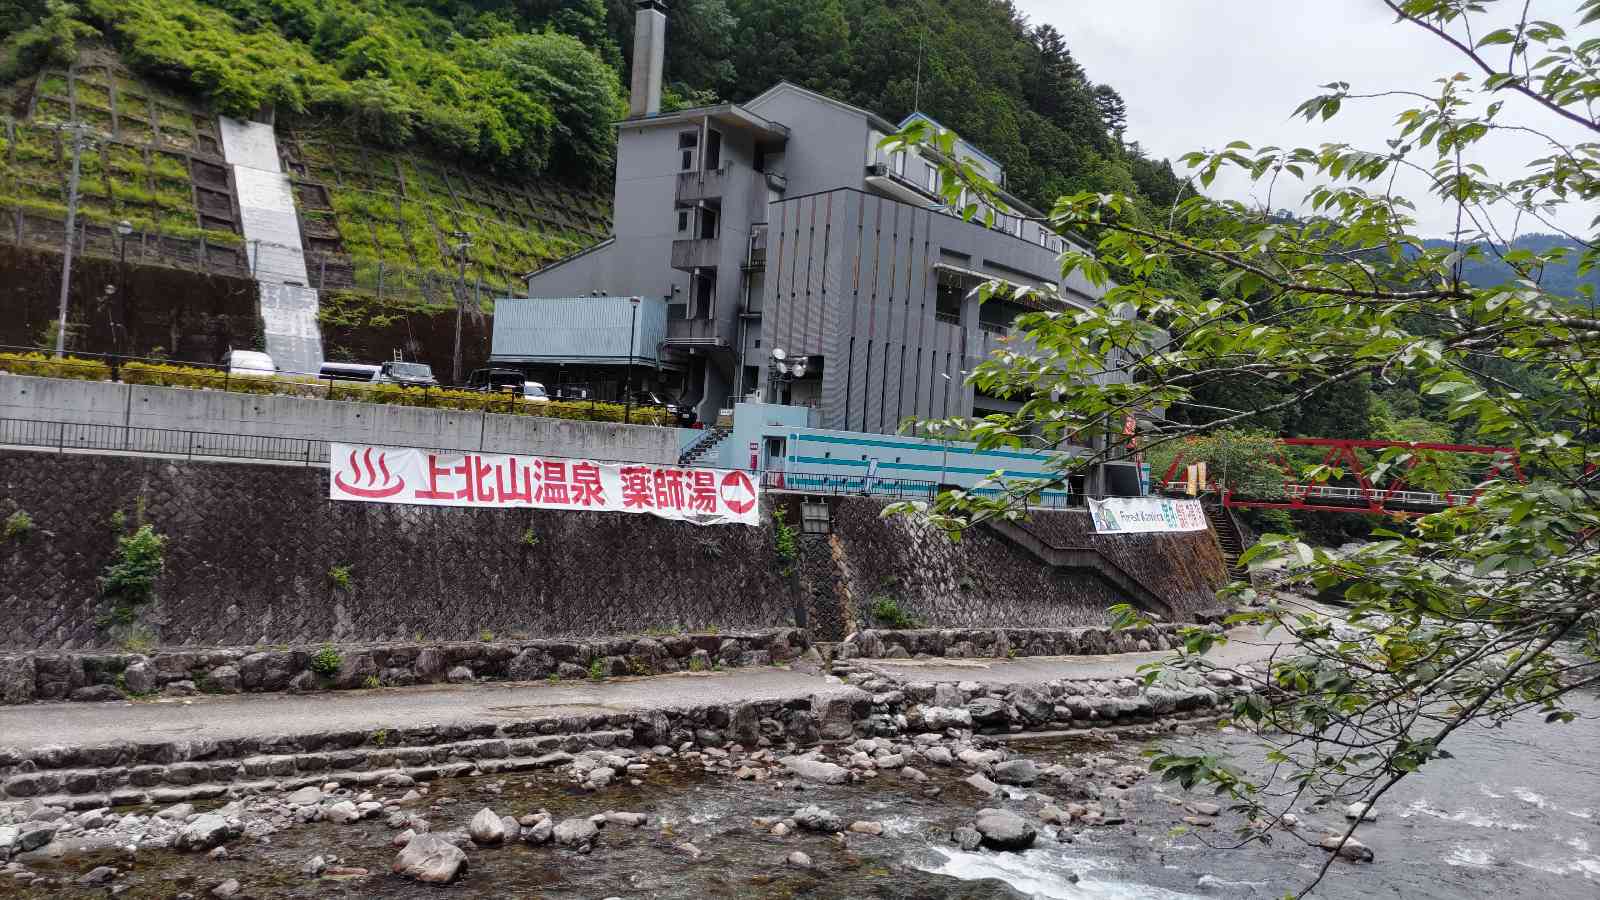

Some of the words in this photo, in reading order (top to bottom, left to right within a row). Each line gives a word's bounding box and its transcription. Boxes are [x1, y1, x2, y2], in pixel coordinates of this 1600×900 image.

[415, 455, 605, 507] 上北山温泉
[619, 466, 717, 513] 薬師湯
